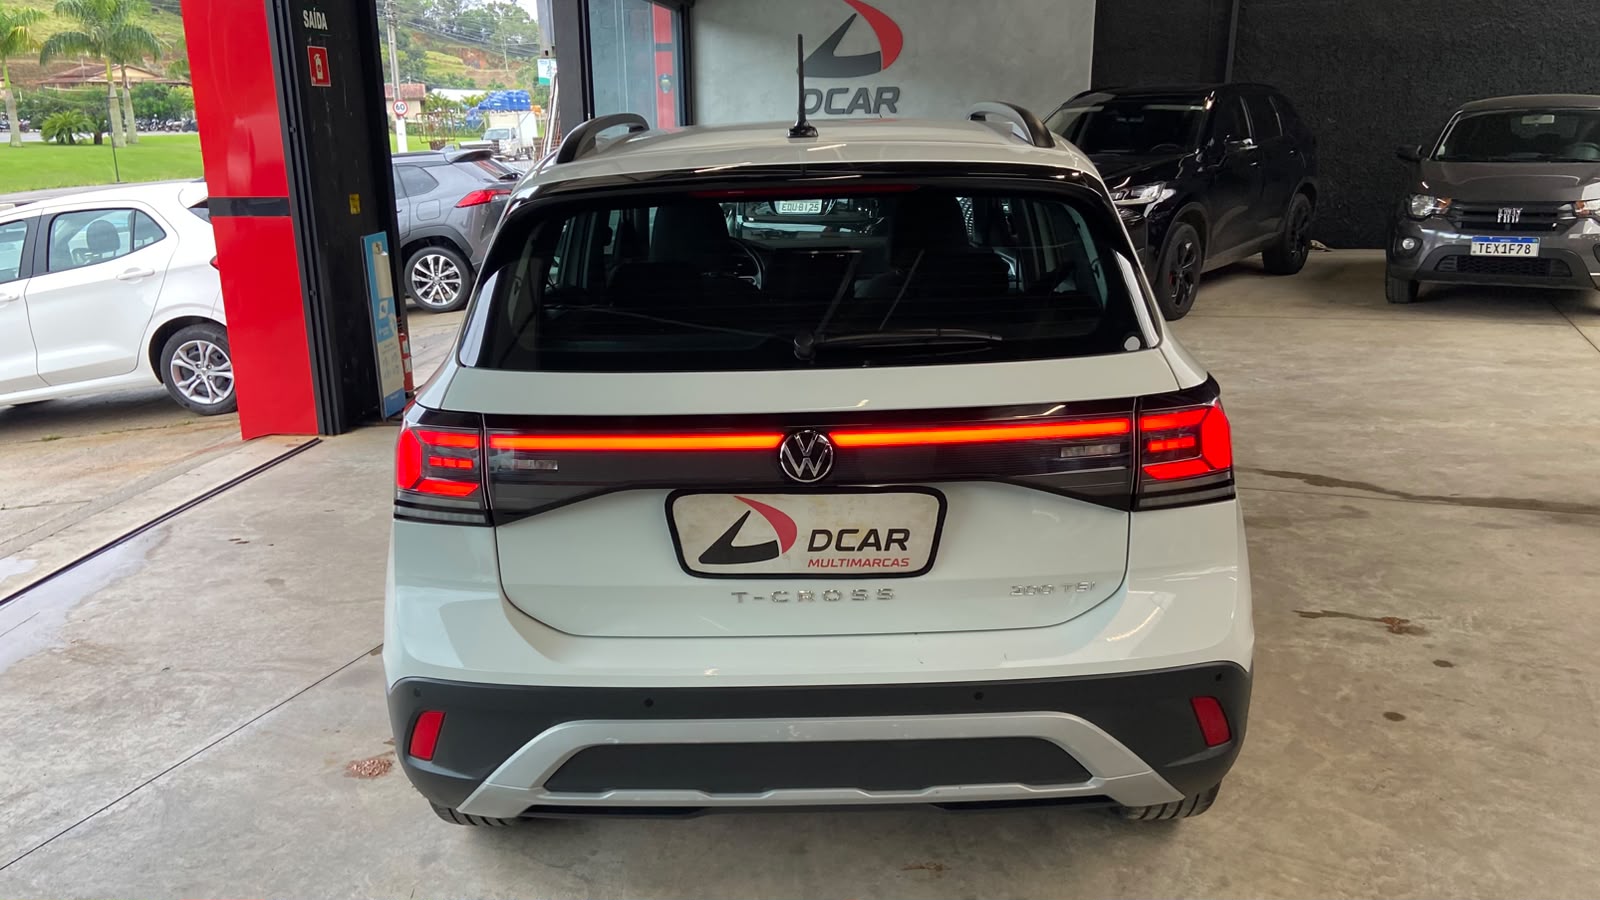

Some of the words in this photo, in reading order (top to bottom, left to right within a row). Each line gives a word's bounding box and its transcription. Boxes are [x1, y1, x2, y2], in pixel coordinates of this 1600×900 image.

[303, 8, 328, 30] SAÍDA
[395, 103, 406, 112] 60
[802, 87, 900, 115] DCAR
[1478, 243, 1531, 254] TEX1F78
[808, 529, 910, 552] DCAR
[808, 558, 910, 568] MULTIMARCAS
[731, 588, 894, 603] T-CROSS
[1010, 584, 1054, 596] 200
[1061, 581, 1096, 592] TSI
